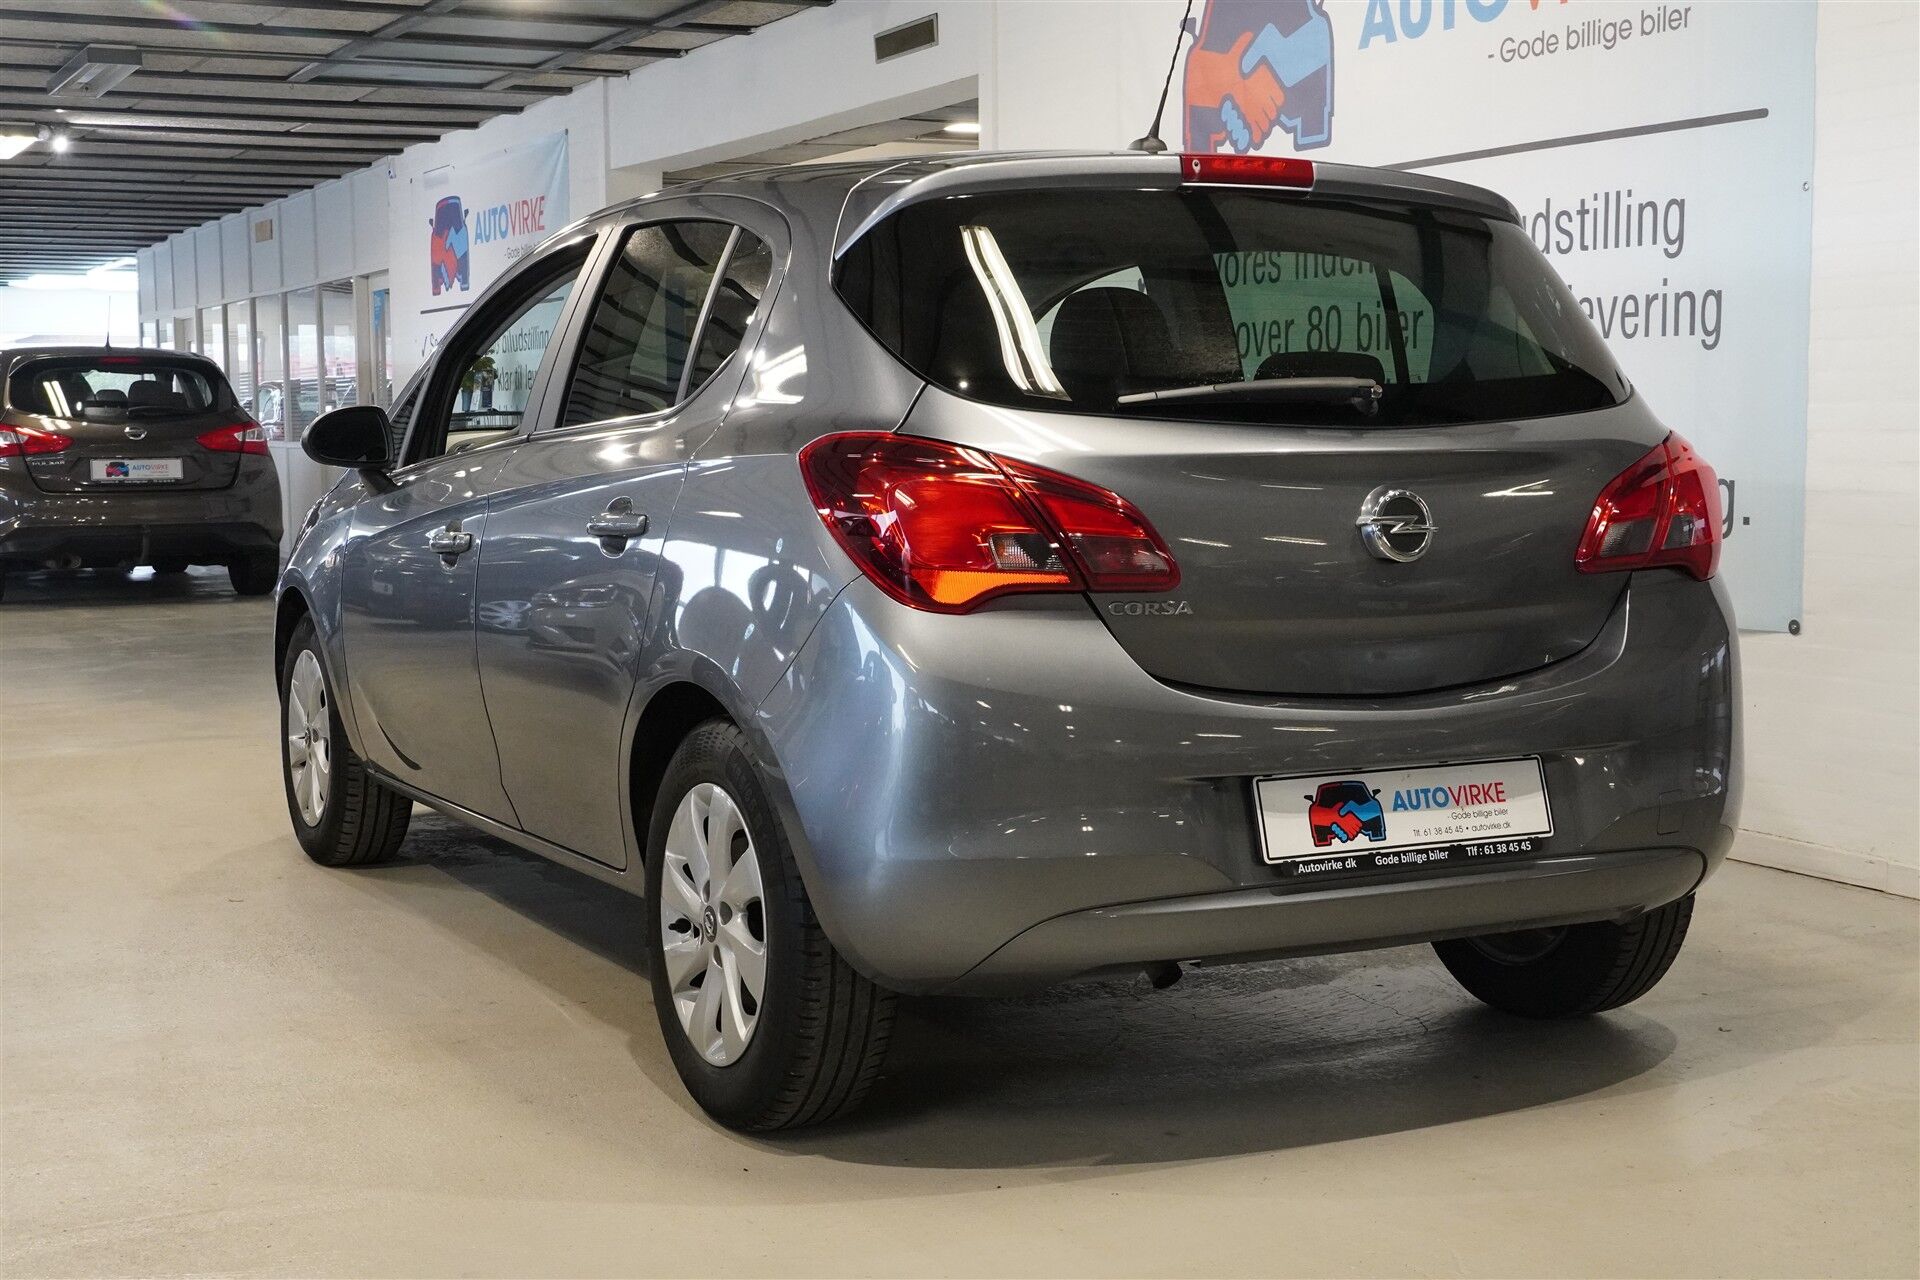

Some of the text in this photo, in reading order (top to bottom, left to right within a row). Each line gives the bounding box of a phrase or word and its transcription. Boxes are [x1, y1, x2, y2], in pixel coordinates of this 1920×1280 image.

[1500, 31, 1559, 63] Gode
[1566, 20, 1633, 51] billige
[1640, 5, 1693, 37] biler
[474, 195, 545, 245] AUTOVIRKE
[1522, 189, 1686, 259] dstilling
[1236, 318, 1295, 360] over
[1306, 305, 1342, 353] 80
[1357, 301, 1424, 352] bier
[1107, 600, 1194, 616] CORSA
[1392, 782, 1506, 812] AUTOVIRKE
[1423, 828, 1432, 837] 61
[1434, 827, 1443, 836] 38
[1444, 826, 1454, 835] 45
[1454, 825, 1464, 834] 45
[1450, 810, 1472, 820] Gode
[1298, 859, 1343, 874] Autovirke
[1345, 857, 1357, 869] dk
[1375, 853, 1399, 866] Gode
[1400, 851, 1428, 864] billige
[1429, 849, 1449, 861] biler
[1484, 844, 1495, 855] 61
[1496, 843, 1507, 854] 38
[1508, 842, 1519, 853] 45
[1520, 841, 1532, 851] 45
